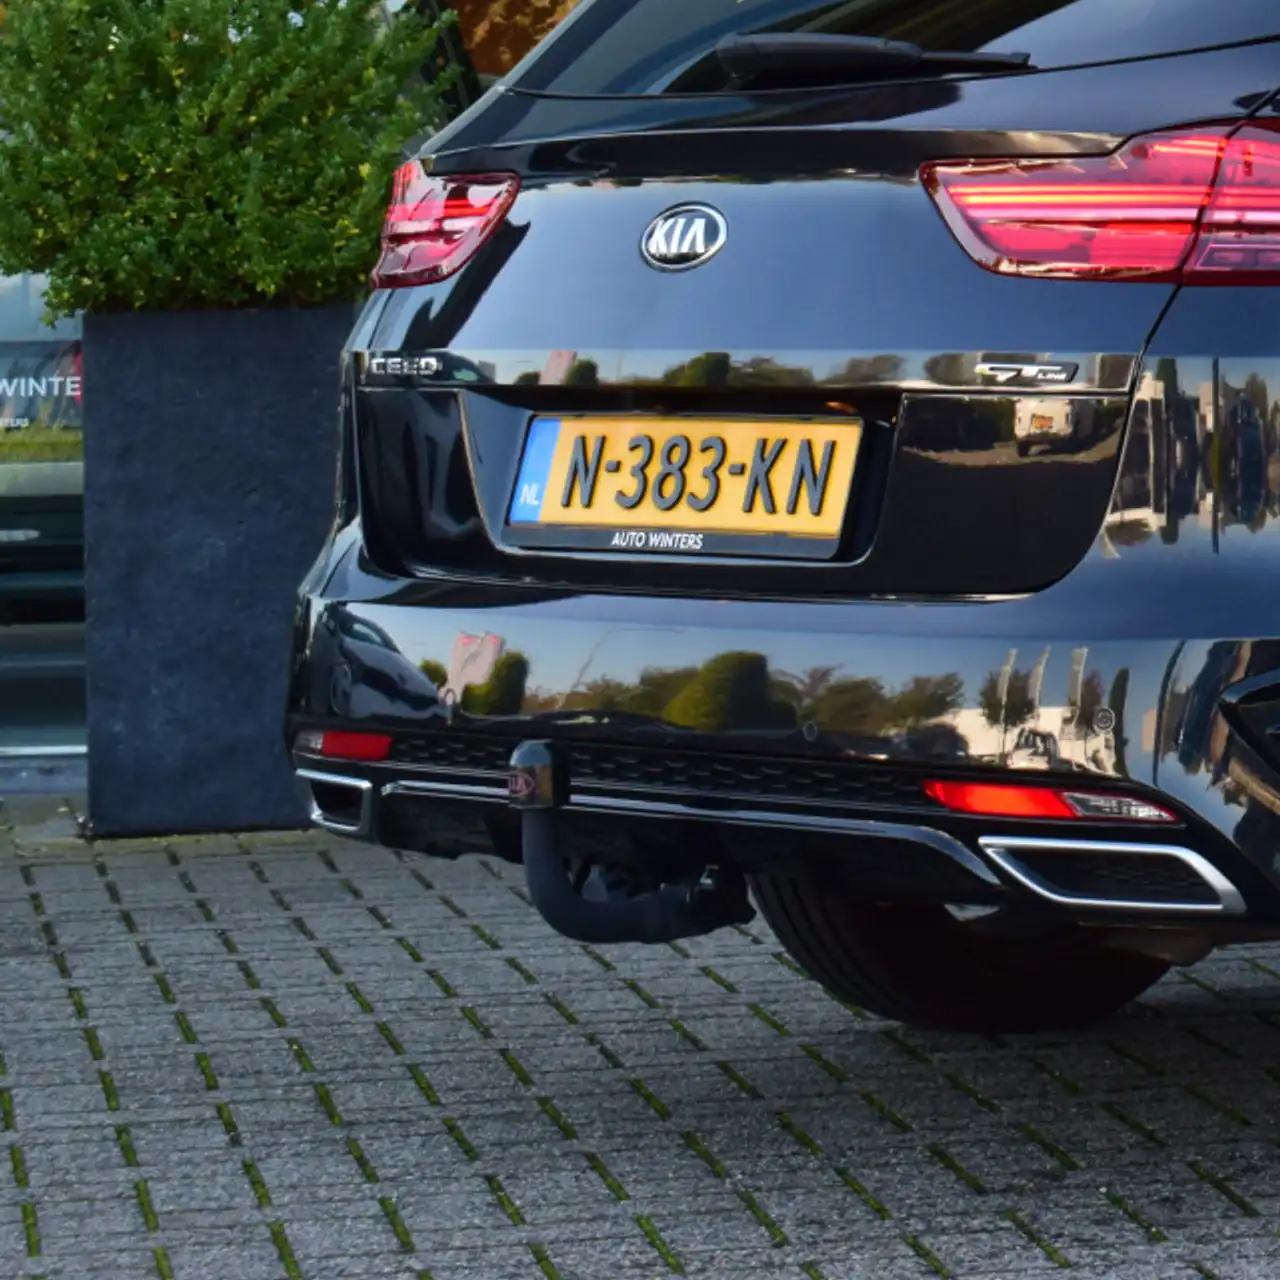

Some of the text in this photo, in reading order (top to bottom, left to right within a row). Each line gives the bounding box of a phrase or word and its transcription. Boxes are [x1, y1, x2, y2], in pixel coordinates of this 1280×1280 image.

[647, 218, 706, 255] KIA
[561, 434, 837, 517] N-383-KN
[520, 483, 541, 506] NL
[611, 531, 703, 551] AUTO WINTERS
